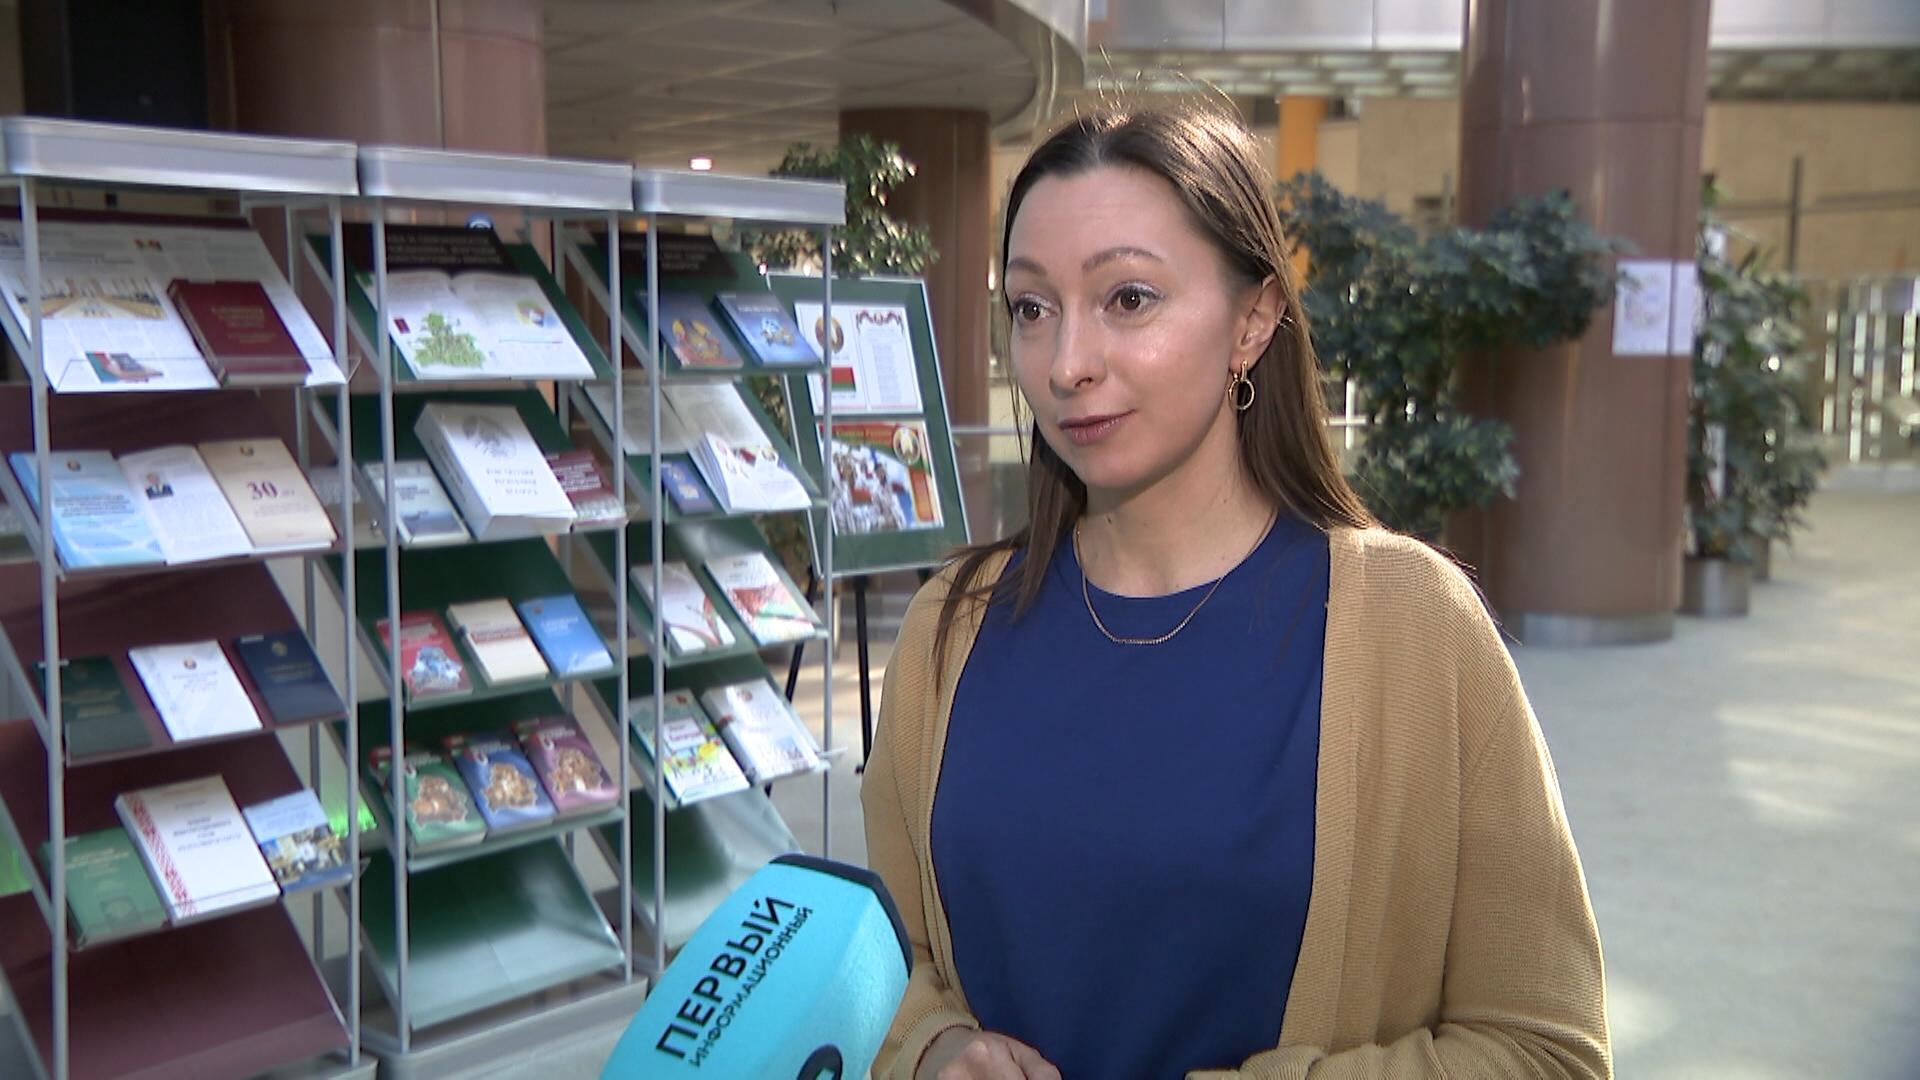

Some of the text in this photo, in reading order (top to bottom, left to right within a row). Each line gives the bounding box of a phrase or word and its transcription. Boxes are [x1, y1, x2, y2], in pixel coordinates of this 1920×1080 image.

[247, 481, 278, 500] 30
[656, 897, 795, 1060] ПЕРВЫЙ
[688, 906, 814, 1068] ИНФОРМАЦИОННЫЙ
